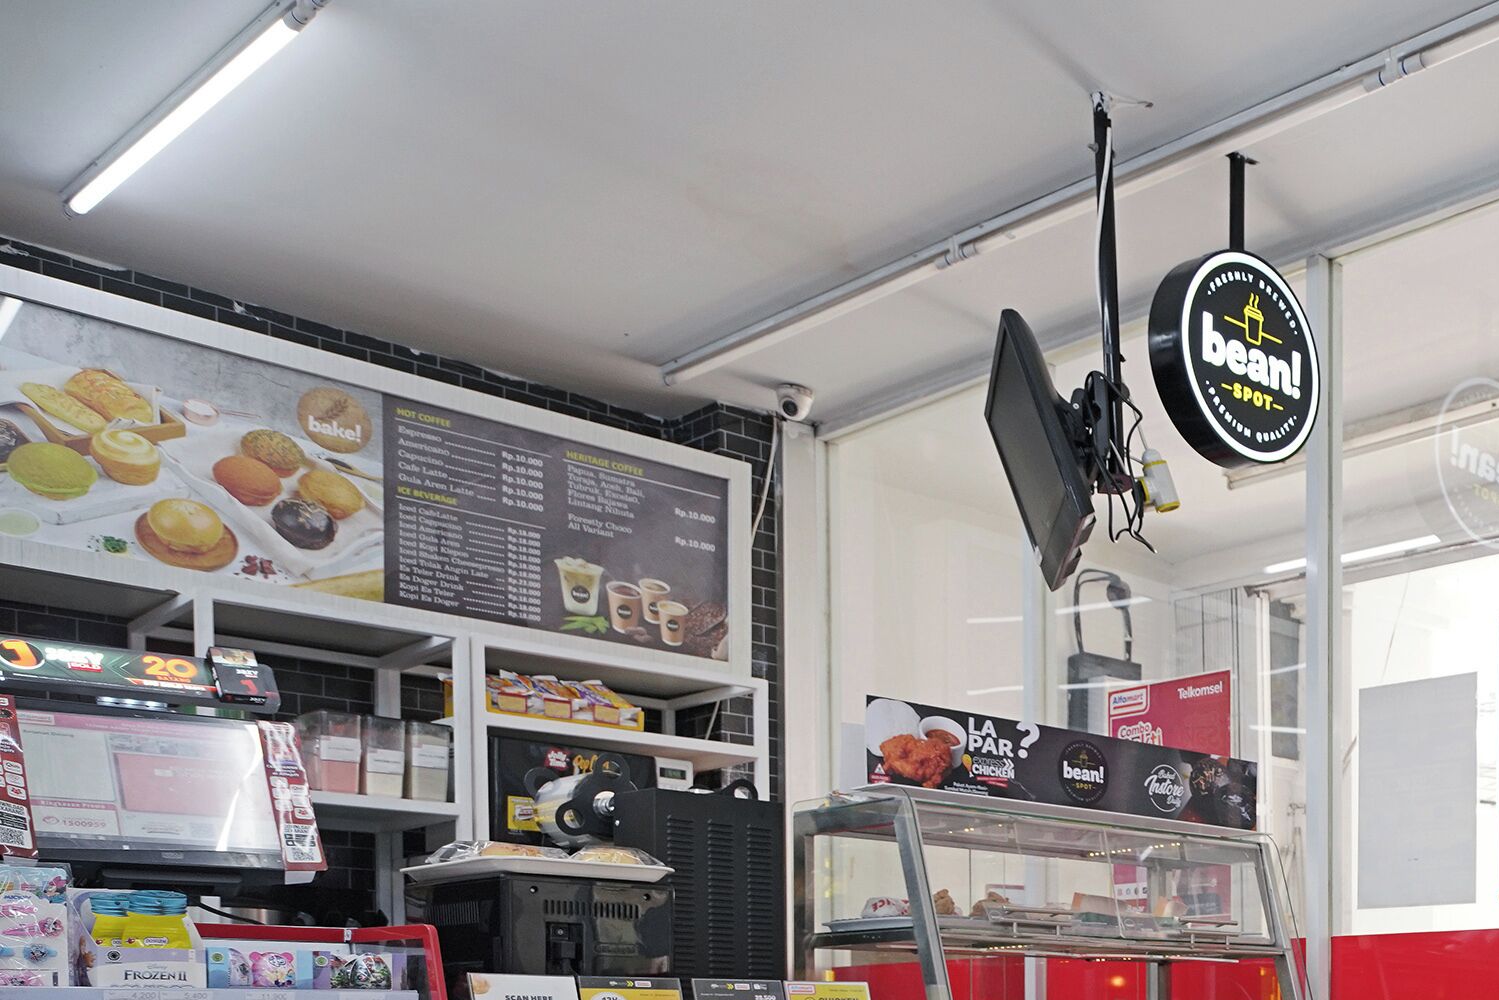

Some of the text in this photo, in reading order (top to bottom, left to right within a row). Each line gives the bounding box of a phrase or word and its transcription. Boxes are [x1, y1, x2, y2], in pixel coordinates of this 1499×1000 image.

[1210, 270, 1297, 330] FRESHLY BREWED
[1202, 310, 1302, 400] bean!
[1232, 382, 1273, 411] SPOT
[396, 407, 451, 427] HOT COFFEE
[1208, 386, 1295, 444] PREMIUM QUALITY
[307, 415, 362, 443] bake!
[397, 438, 544, 479] Americano Rp.10.000
[398, 425, 544, 468] Espresso Rp.10.000
[566, 450, 645, 477] HERITAGE COFFEE
[422, 466, 448, 480] Latte
[501, 485, 544, 501] Rp.10.000
[501, 473, 544, 490] Rp.10.000
[424, 478, 447, 491] Aren
[450, 484, 475, 497] Latte
[501, 496, 544, 512] Rp.10.000
[142, 655, 198, 679] 20
[1112, 680, 1223, 705] Alfamart Telkomsel
[967, 716, 998, 739] LA
[1119, 721, 1152, 739] Combo
[967, 734, 1014, 758] PAR
[971, 763, 1015, 780] CHICKEN
[1062, 760, 1104, 784] bean!
[1144, 774, 1184, 797] Instore
[124, 969, 187, 981] FROZEN II
